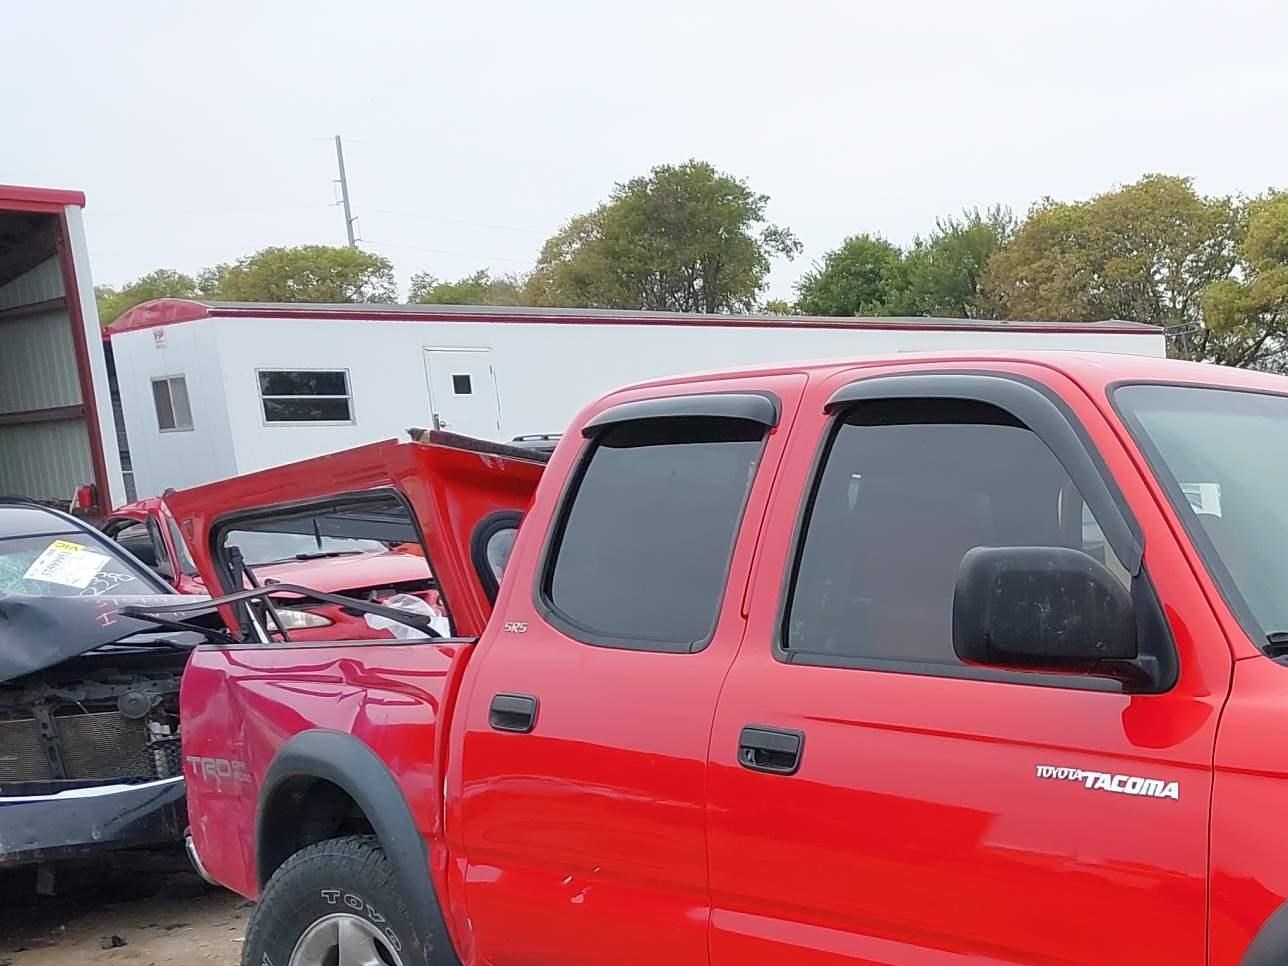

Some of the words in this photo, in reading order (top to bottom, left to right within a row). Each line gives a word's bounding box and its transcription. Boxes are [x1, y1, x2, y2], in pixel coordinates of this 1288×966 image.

[186, 755, 232, 782] TRD
[1036, 765, 1083, 781] TOYOTA
[1081, 771, 1179, 800] TACOMA
[321, 889, 401, 951] TOYO
